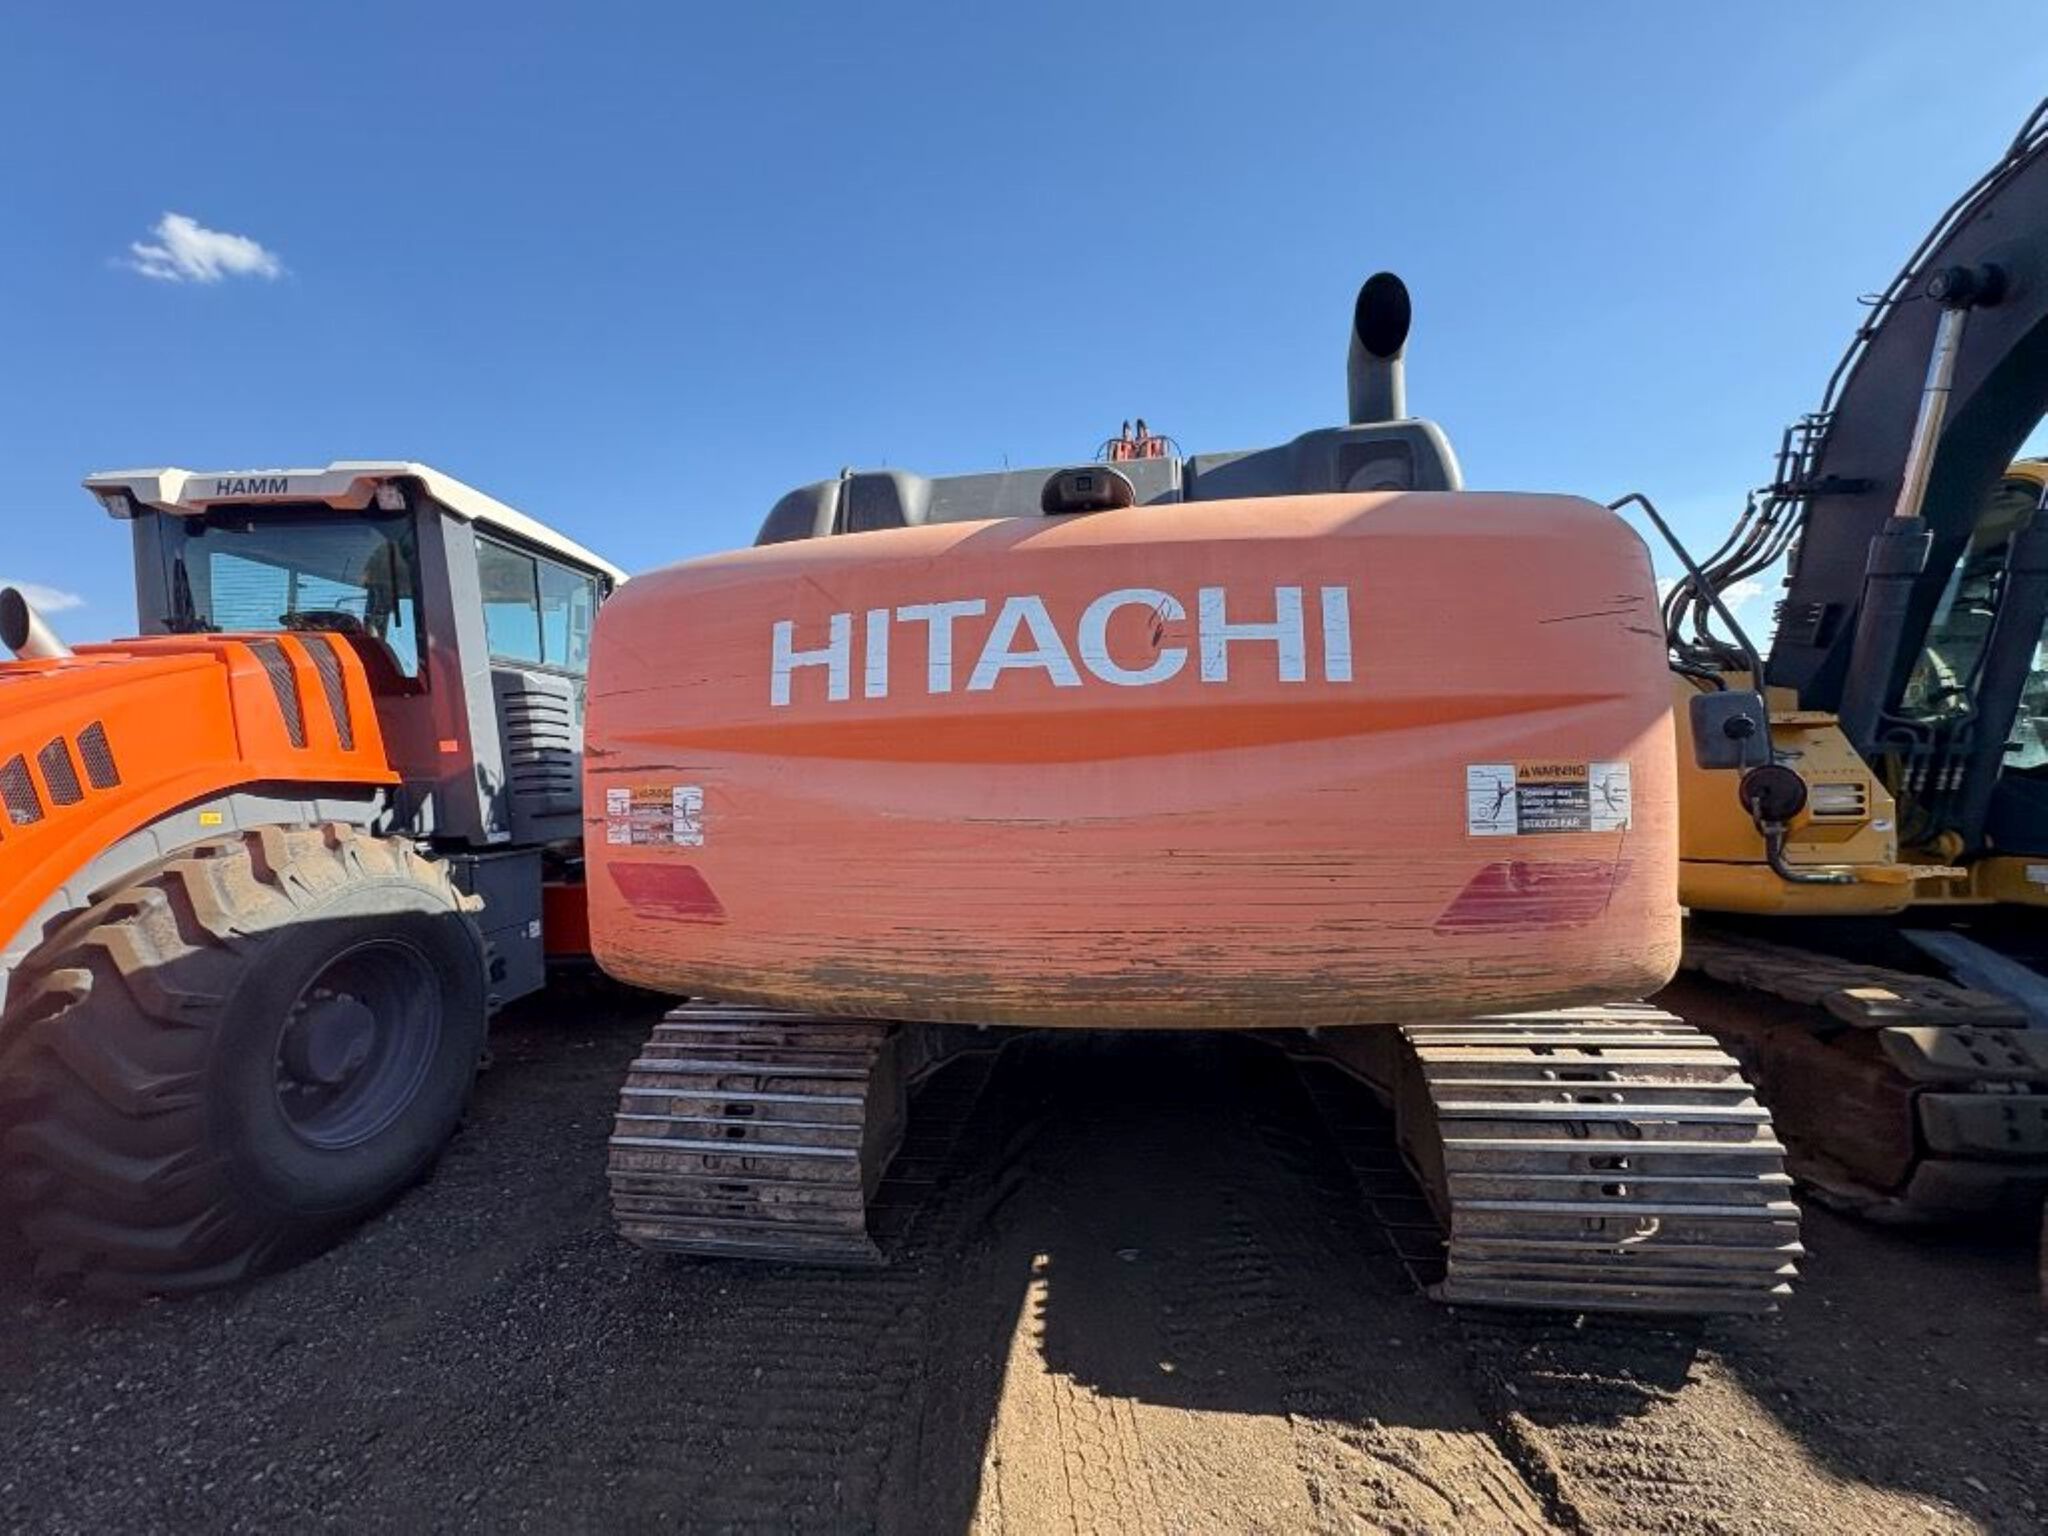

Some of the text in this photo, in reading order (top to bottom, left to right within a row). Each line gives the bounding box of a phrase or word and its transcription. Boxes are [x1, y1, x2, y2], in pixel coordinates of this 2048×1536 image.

[216, 478, 288, 496] HAMM
[770, 586, 1353, 706] HITACHI
[1531, 765, 1585, 776] WARNING
